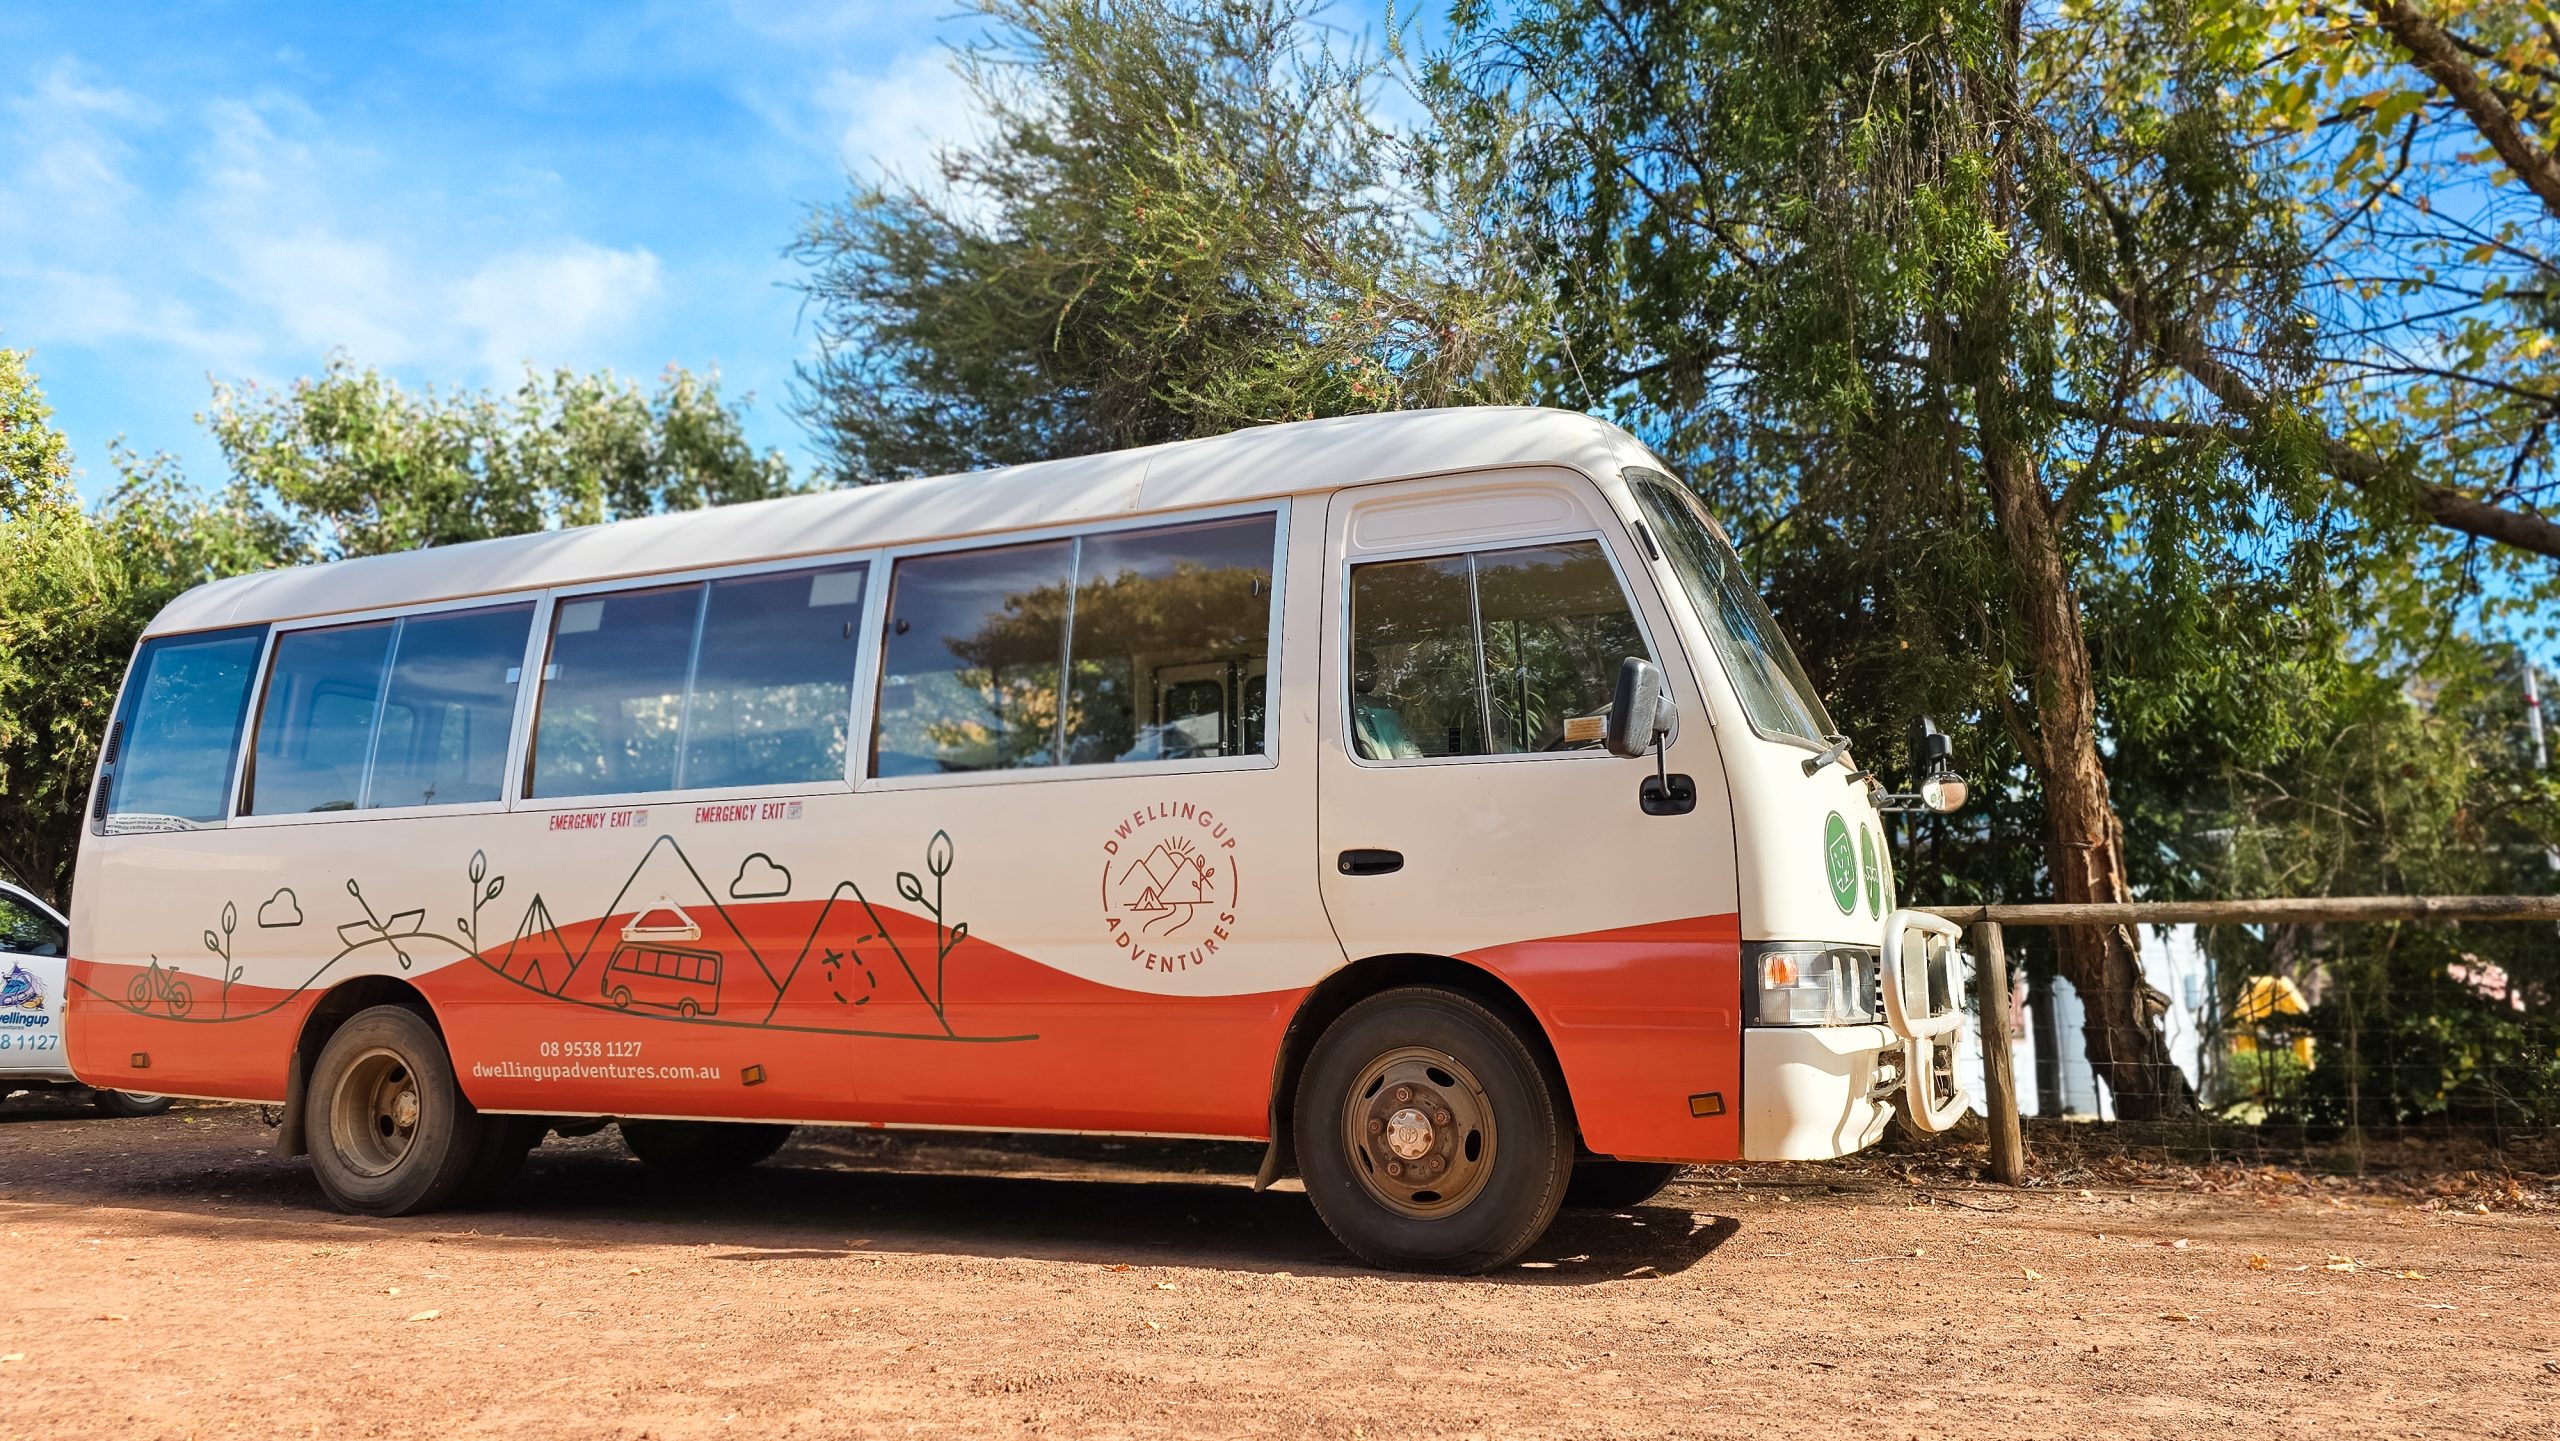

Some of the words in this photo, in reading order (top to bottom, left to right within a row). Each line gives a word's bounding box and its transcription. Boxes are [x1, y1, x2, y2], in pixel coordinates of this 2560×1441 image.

[549, 812, 606, 831] EMERGENCY
[610, 811, 632, 828] EXIT
[695, 804, 757, 823] EMERGENCY
[762, 802, 786, 820] EXIT
[1104, 802, 1236, 855] DWELLINGUP
[1106, 911, 1235, 973] ADVENTURES
[0, 1012, 49, 1027] ellingup
[17, 1034, 58, 1050] 1127
[540, 1041, 560, 1057] 08
[563, 1041, 602, 1057] 9538
[606, 1041, 642, 1057] 1127
[472, 1061, 721, 1082] dwellingupadventures.com.au
